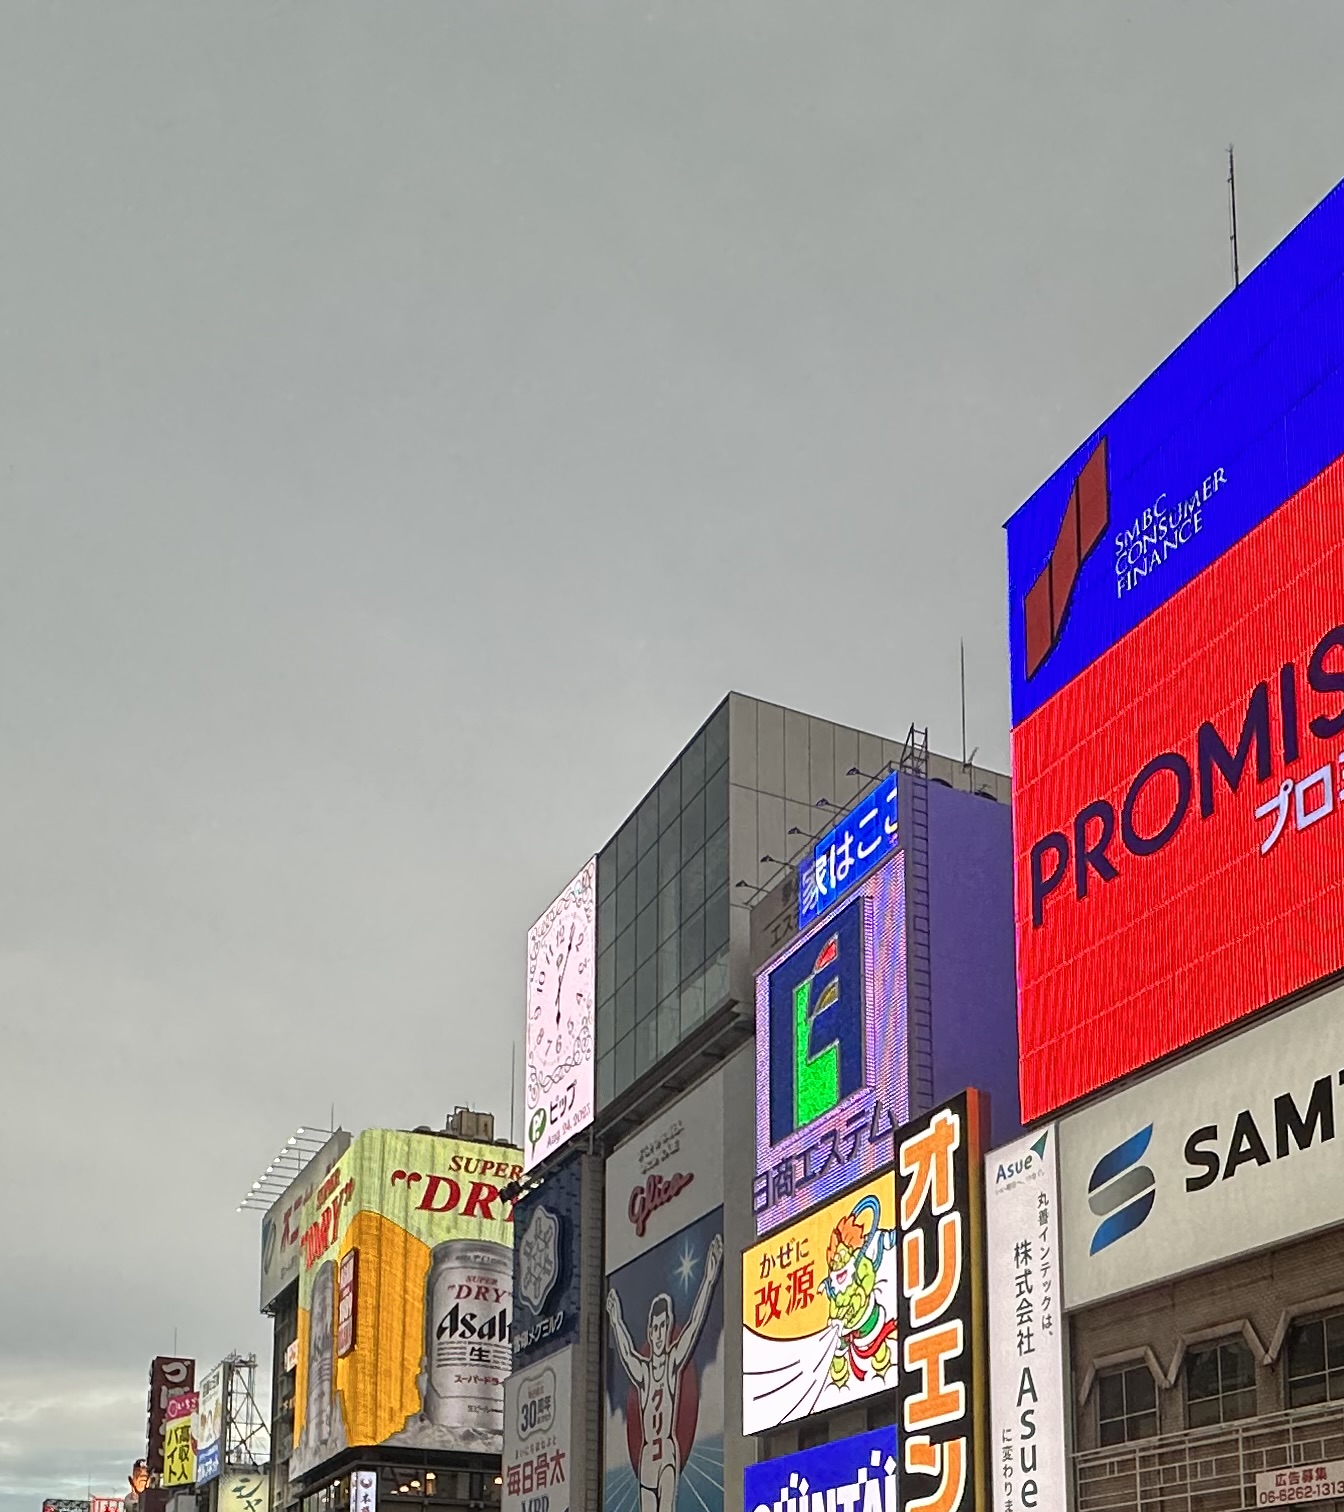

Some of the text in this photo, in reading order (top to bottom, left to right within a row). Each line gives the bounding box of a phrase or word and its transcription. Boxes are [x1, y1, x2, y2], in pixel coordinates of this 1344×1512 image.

[1115, 467, 1228, 576] CONSUMER
[1115, 492, 1167, 556] SMBC
[1117, 510, 1203, 599] FINANCE
[549, 1079, 578, 1125] ピップ
[449, 1155, 525, 1179] SUPER
[753, 1102, 899, 1212] 日商エステム
[995, 1154, 1033, 1185] Asue
[628, 1171, 694, 1238] Glico
[759, 1237, 810, 1280] かぜに
[754, 1261, 816, 1328] 改源
[469, 1346, 492, 1364] 生
[1014, 1239, 1039, 1510] 株式会社 Asue
[521, 1400, 537, 1433] 30
[167, 1426, 178, 1482] バイト
[507, 1449, 566, 1497] 毎日骨太
[1275, 1466, 1328, 1487] 広告募集
